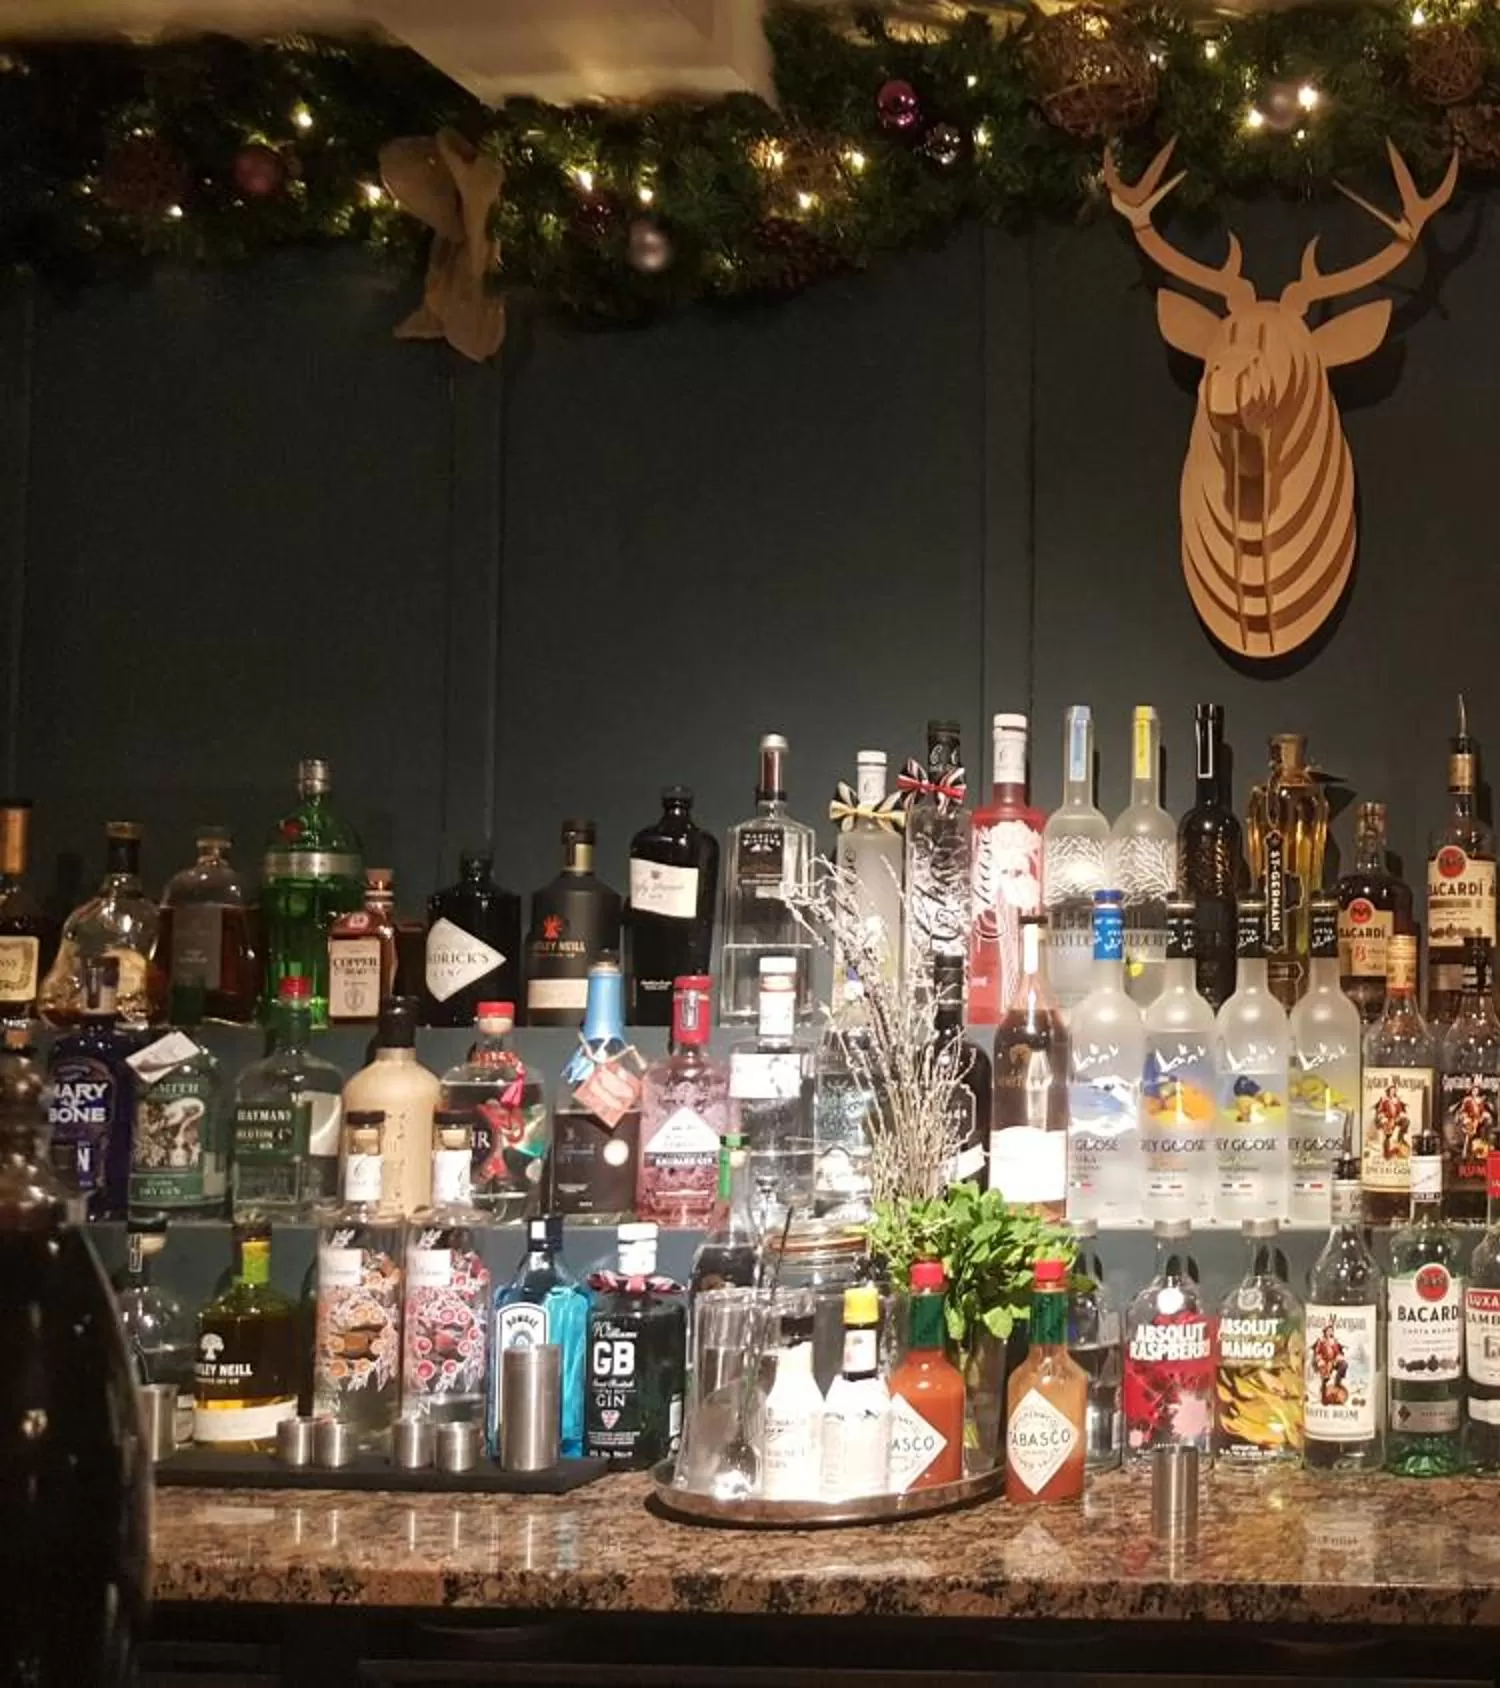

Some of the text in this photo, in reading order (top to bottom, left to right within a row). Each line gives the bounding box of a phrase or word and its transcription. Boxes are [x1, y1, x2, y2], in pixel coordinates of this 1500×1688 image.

[1269, 850, 1281, 931] ST-GERMAIN
[48, 1107, 106, 1123] BONE
[1136, 1321, 1207, 1344] ABSOLUT
[593, 1340, 635, 1376] GB
[219, 1363, 254, 1377] NEILL
[595, 1393, 626, 1408] GIN
[1008, 1427, 1071, 1448] TABASCO
